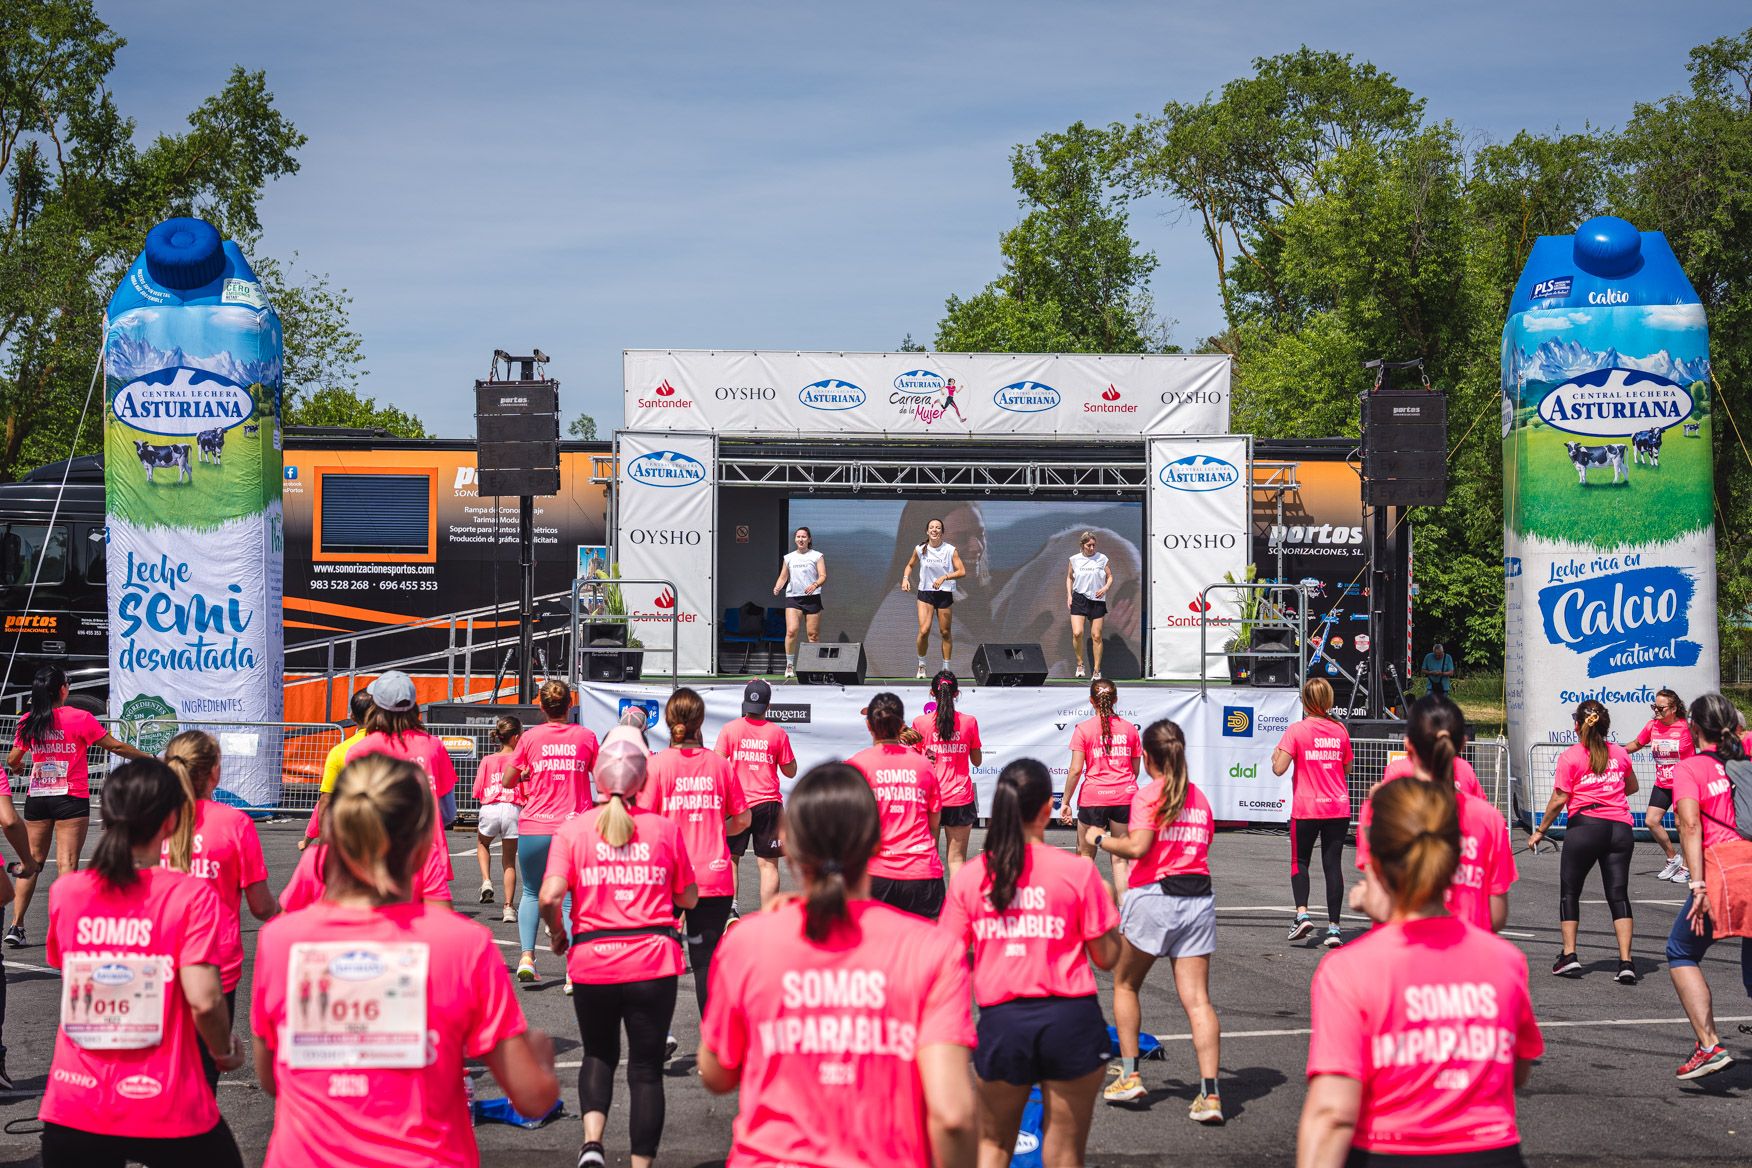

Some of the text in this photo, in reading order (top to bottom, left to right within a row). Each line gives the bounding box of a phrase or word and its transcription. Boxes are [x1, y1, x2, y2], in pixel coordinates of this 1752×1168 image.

[227, 285, 250, 294] CERO
[1535, 280, 1554, 295] PLS
[898, 379, 941, 388] ASTURIANA
[715, 387, 776, 400] OYSHO
[804, 390, 861, 404] ASTURIANA
[889, 392, 931, 404] Carrera
[999, 392, 1056, 405] ASTURIANA
[1161, 391, 1221, 405] OYSHO
[120, 392, 243, 418] ASTURIANA
[638, 398, 692, 408] Santander
[1084, 403, 1138, 414] Santander
[1550, 395, 1682, 421] ASTURIANA
[909, 406, 915, 414] la
[914, 404, 947, 424] Mujer
[634, 463, 700, 479] ASTURIANA
[1166, 468, 1232, 483] ASTURIANA
[630, 529, 701, 545] OYSHO
[1164, 534, 1235, 549] OYSHO
[1268, 524, 1363, 547] portos
[122, 552, 192, 593] Leche
[314, 563, 434, 575] www.sonorizacionesportos.com
[1548, 554, 1641, 584] Leche rica en
[310, 580, 438, 590] 983 528 268 696 455 353
[118, 584, 253, 638] semi
[1553, 583, 1677, 643] Calcio
[5, 615, 57, 627] portos
[119, 636, 258, 672] desnatada
[1610, 639, 1676, 667] natural
[765, 709, 807, 721] trogena
[1258, 714, 1288, 723] Correos
[542, 744, 576, 757] SOMOS
[741, 739, 768, 750] SOMOS
[1314, 738, 1340, 748] SOMOS
[876, 769, 917, 784] SOMOS
[1229, 763, 1257, 778] dial
[676, 777, 713, 792] SOMOS
[581, 866, 666, 887] IMPARABLES
[77, 916, 153, 947] SOMOS
[782, 969, 887, 1009] SOMOS
[94, 1000, 130, 1014] 016
[1405, 982, 1498, 1022] SOMOS
[331, 1000, 380, 1021] 016
[54, 1069, 97, 1088] OYSHO
